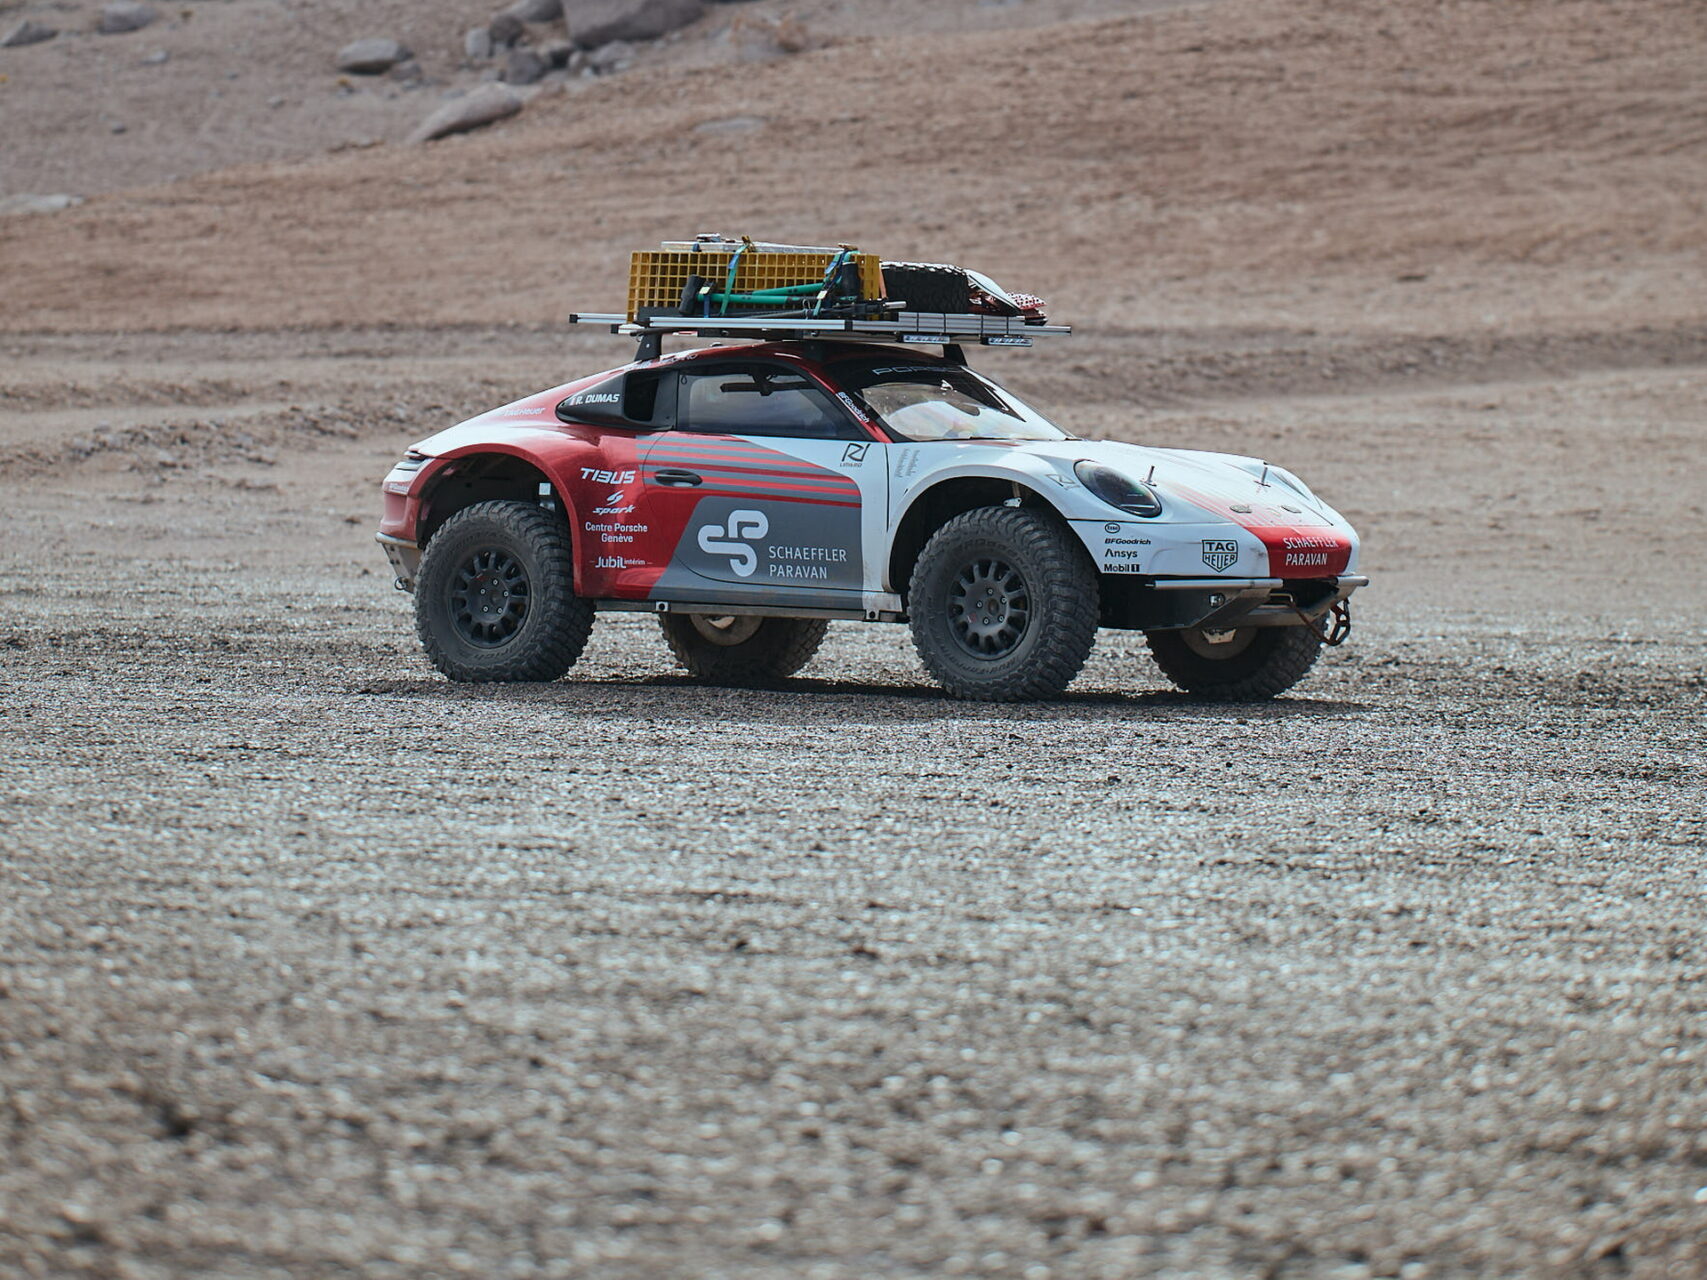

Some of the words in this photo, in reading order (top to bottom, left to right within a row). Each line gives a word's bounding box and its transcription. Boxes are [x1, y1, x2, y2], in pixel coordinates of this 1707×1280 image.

[576, 396, 583, 405] R.
[585, 393, 620, 404] DUMAS
[581, 467, 636, 485] TIBUS
[592, 505, 636, 515] spark
[585, 522, 612, 532] Centre
[614, 523, 648, 532] Porsche
[601, 533, 633, 543] Genève
[1283, 536, 1340, 549] SCHAEFFLER
[1205, 542, 1236, 552] TAG
[768, 545, 848, 563] SCHAEFFLER
[1105, 548, 1139, 560] Ansys
[1286, 553, 1328, 566] PARAVAN
[1204, 554, 1236, 570] HEUER
[769, 564, 828, 580] PARAVAN
[1104, 564, 1130, 573] Mobil
